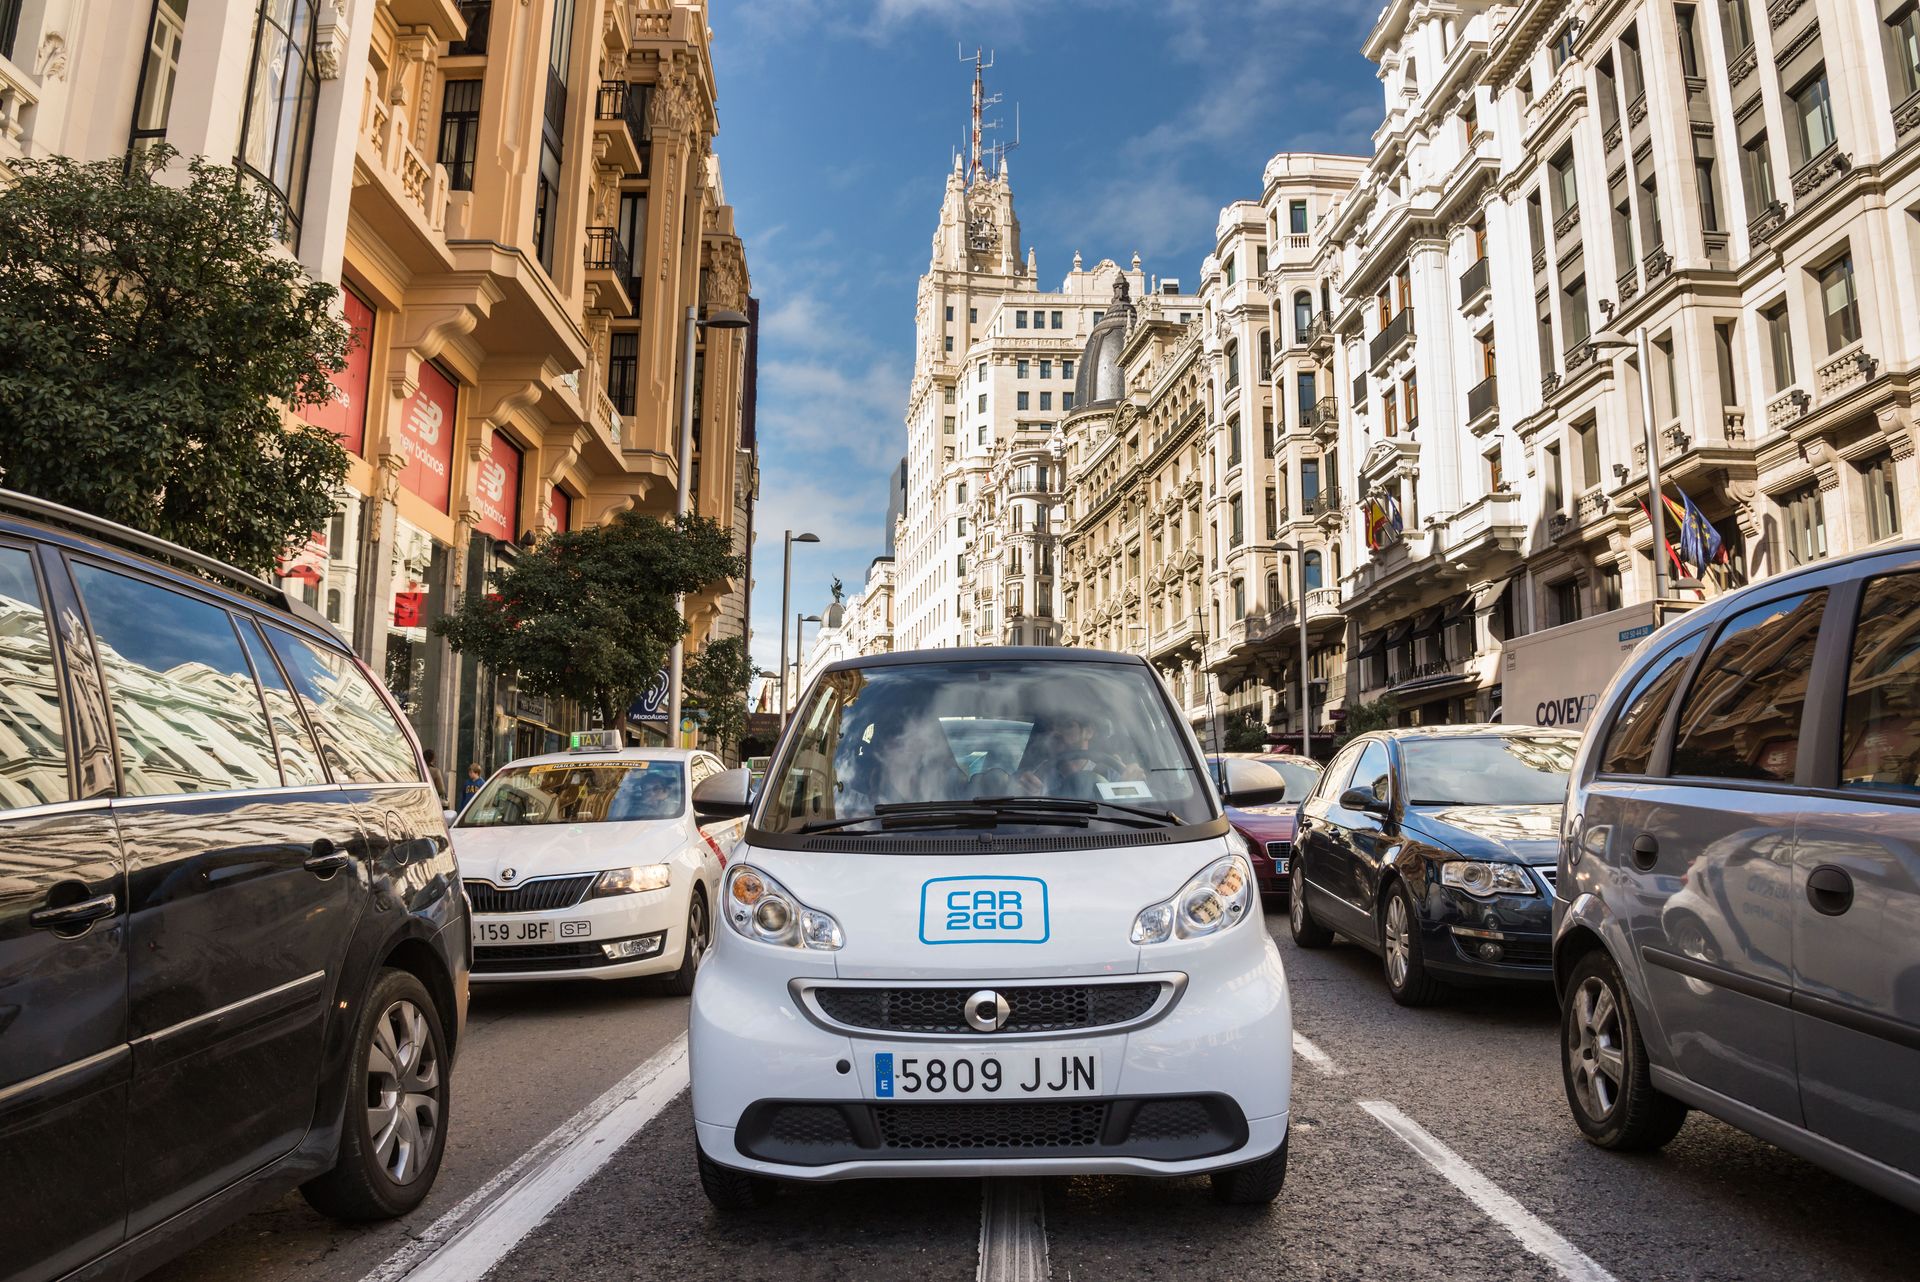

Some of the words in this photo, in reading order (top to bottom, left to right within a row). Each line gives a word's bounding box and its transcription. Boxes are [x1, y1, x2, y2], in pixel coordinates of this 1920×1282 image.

[415, 441, 444, 476] balance
[580, 734, 603, 746] TAXI
[947, 890, 1022, 910] CAR
[564, 923, 588, 935] SP
[946, 911, 1023, 930] 2GO
[473, 924, 509, 941] 159
[517, 922, 549, 940] JBF
[902, 1058, 1002, 1093] 5809
[1020, 1056, 1096, 1092] JJN
[880, 1079, 889, 1090] E
